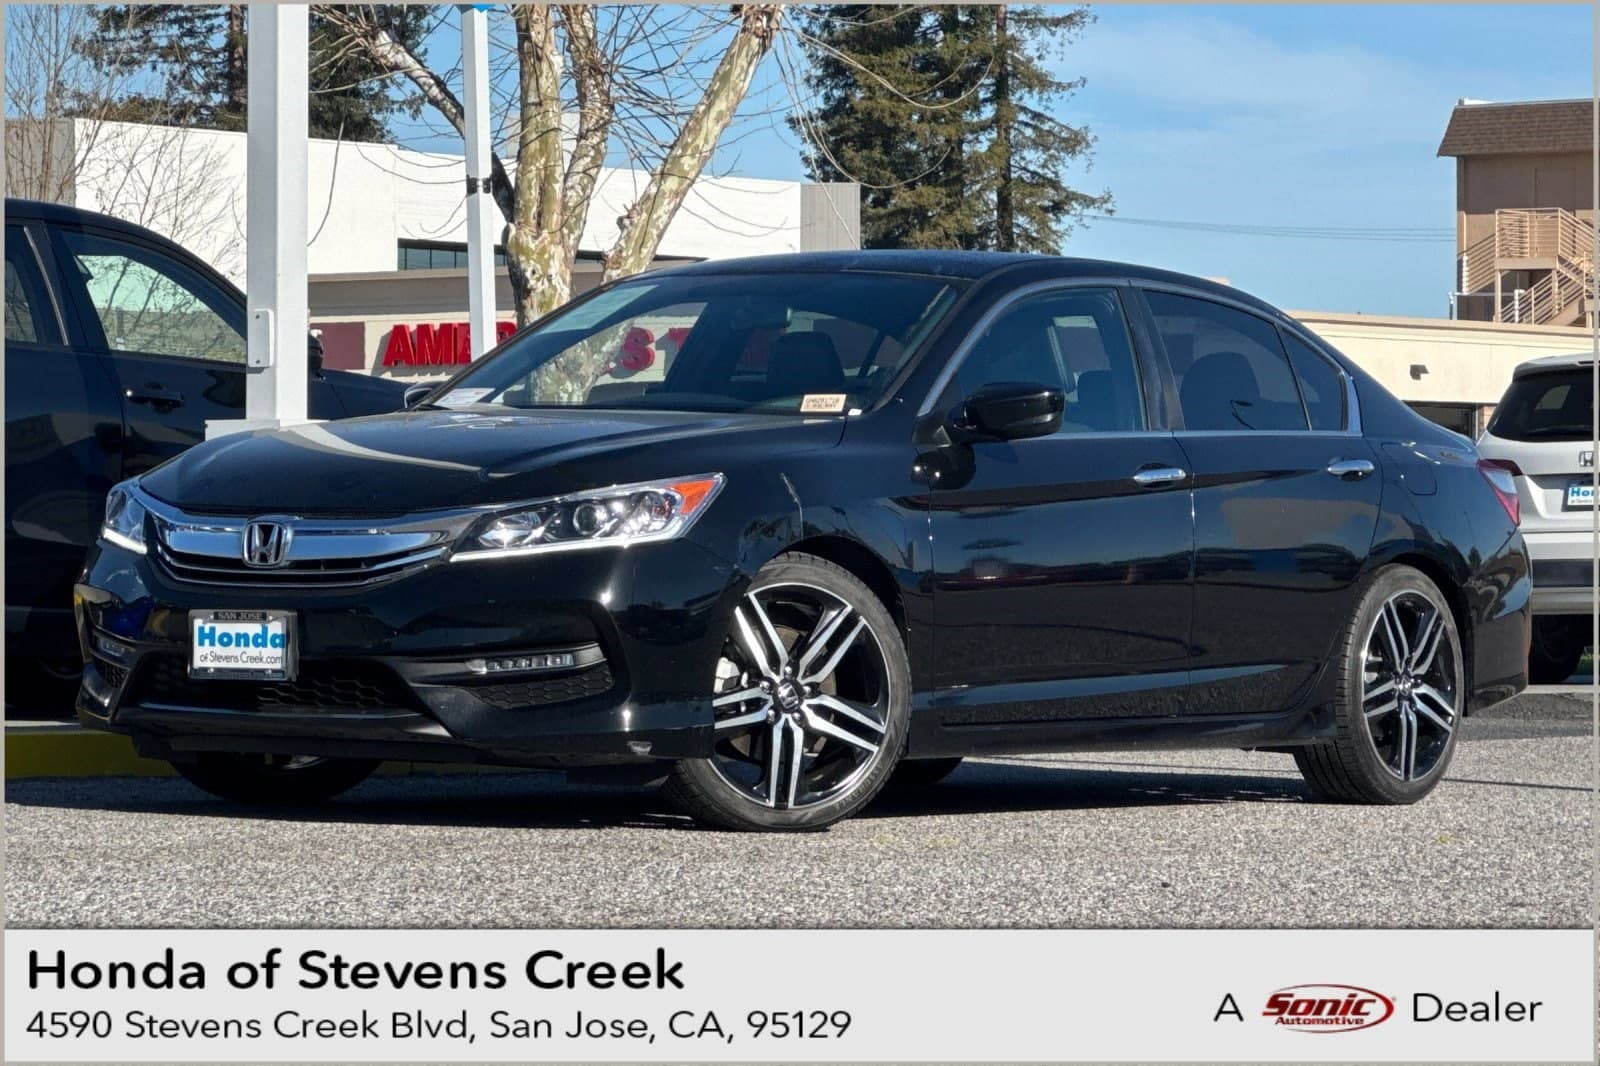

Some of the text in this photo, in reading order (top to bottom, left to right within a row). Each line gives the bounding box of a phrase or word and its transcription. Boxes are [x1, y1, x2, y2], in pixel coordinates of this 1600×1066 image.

[218, 612, 236, 620] SAN
[198, 625, 285, 648] Honda
[200, 653, 209, 663] of
